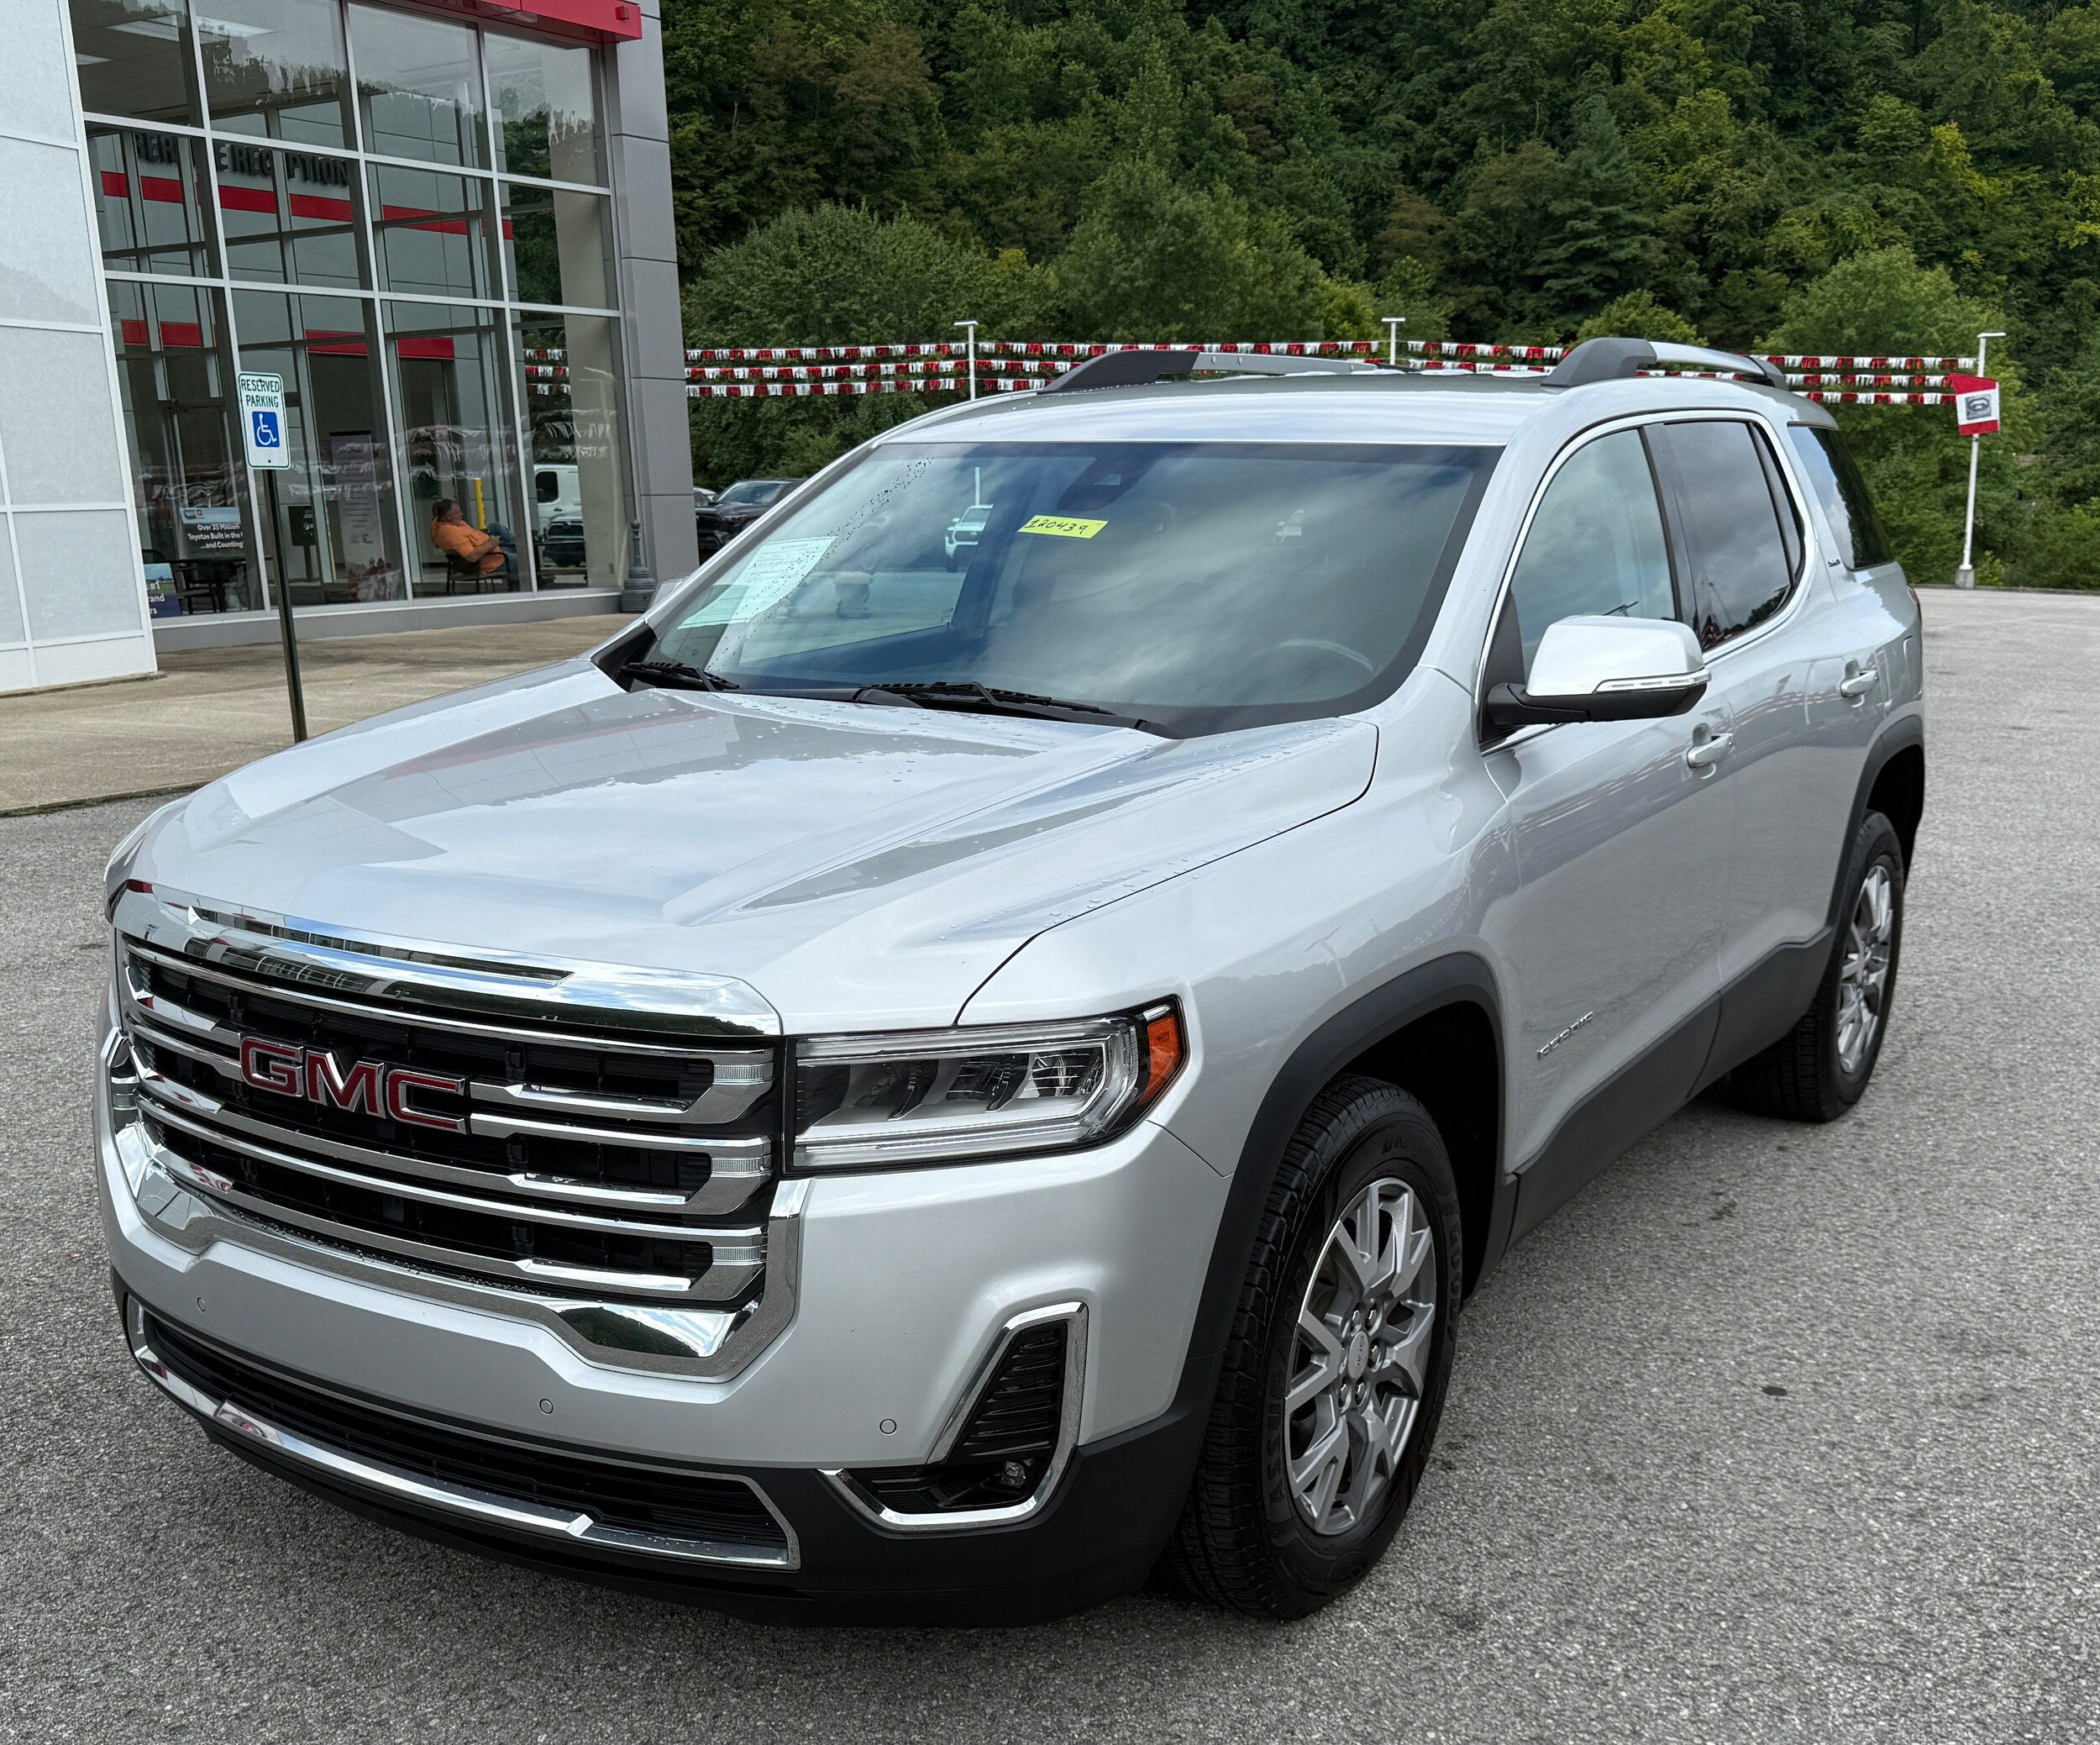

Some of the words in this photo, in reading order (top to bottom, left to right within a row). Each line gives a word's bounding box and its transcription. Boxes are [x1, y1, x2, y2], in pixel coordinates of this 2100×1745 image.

[135, 132, 228, 171] SERE
[230, 144, 349, 187] RECPTION
[240, 378, 280, 392] RESERVED
[245, 394, 279, 408] PARKING
[187, 533, 210, 542] Toyotas
[240, 1036, 467, 1135] GMC
